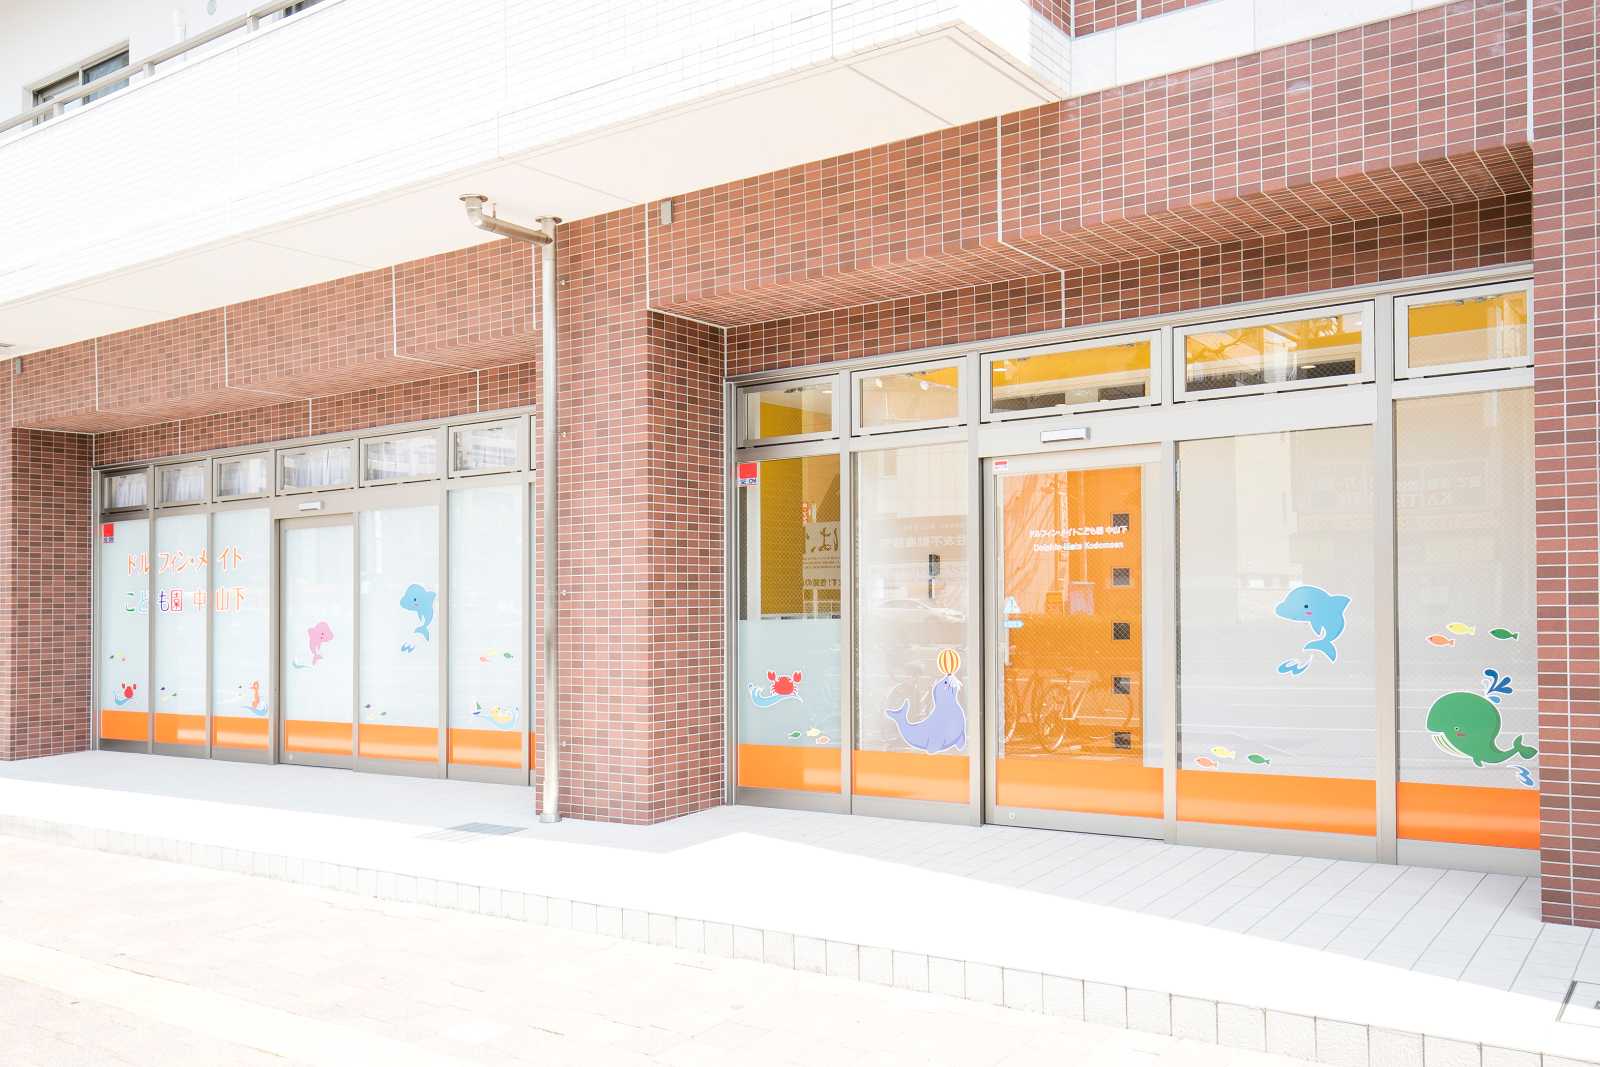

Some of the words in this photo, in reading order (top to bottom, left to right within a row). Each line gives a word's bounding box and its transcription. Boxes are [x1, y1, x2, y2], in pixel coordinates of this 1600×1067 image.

[125, 588, 182, 613] こども園
[193, 587, 246, 612] 中山下
